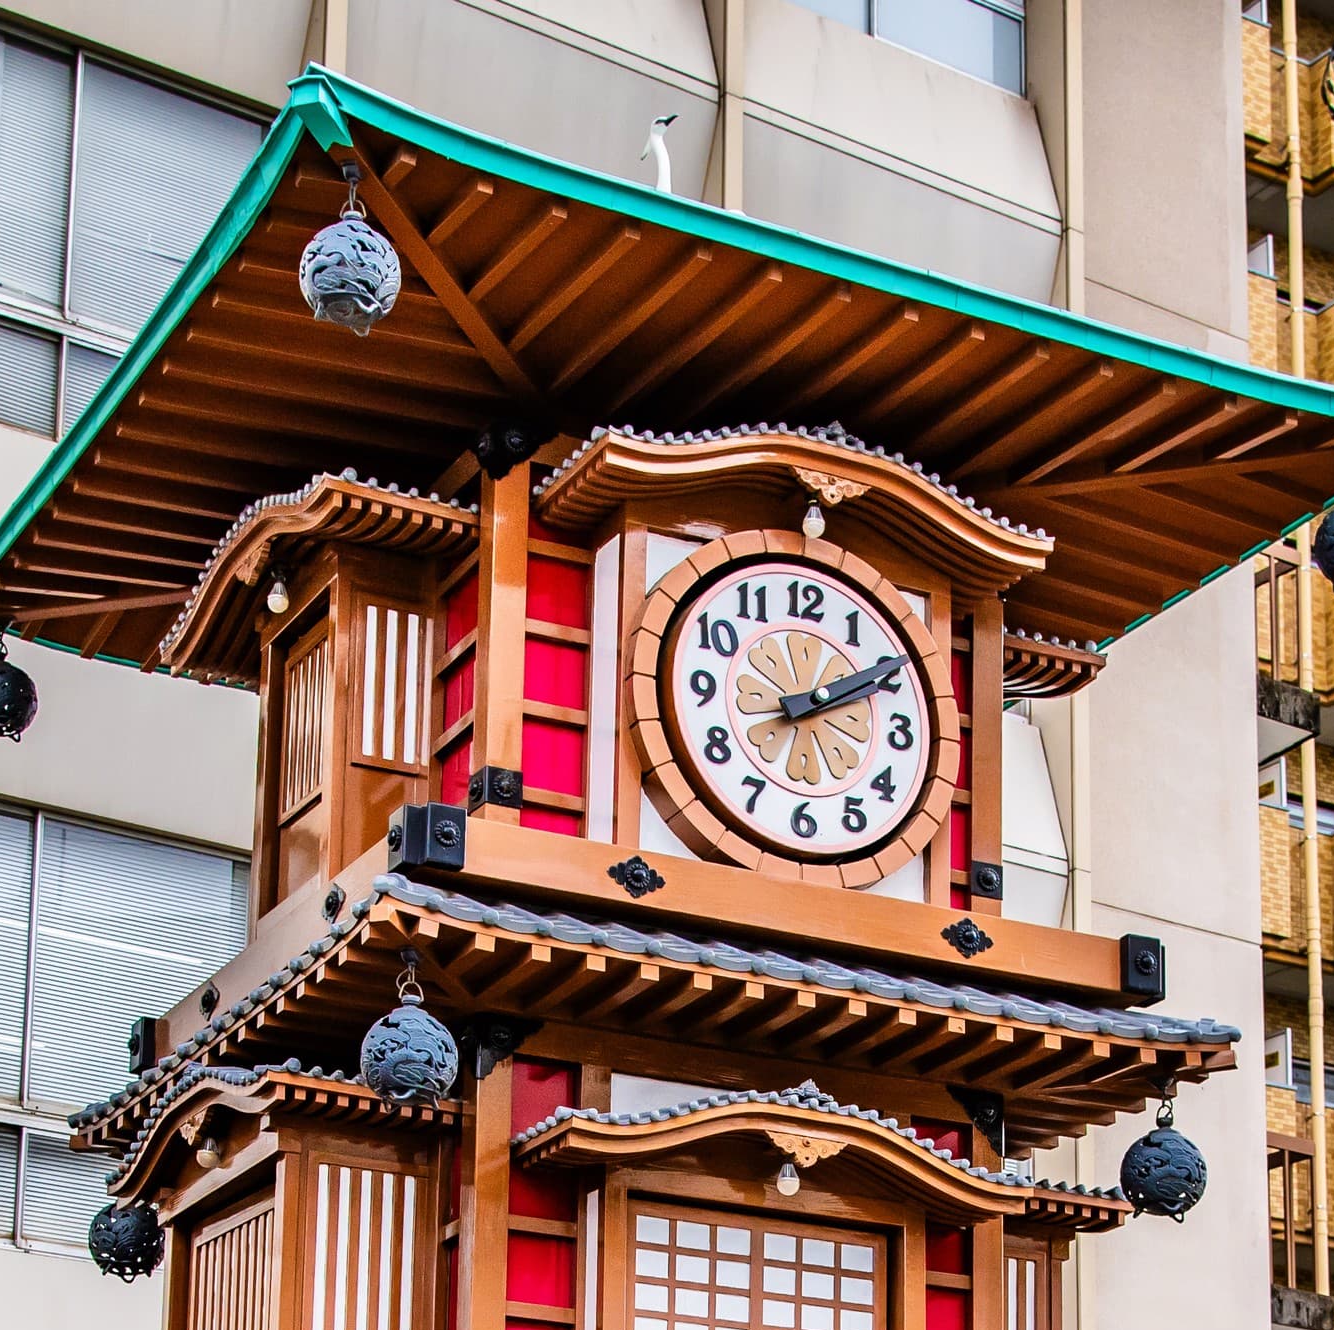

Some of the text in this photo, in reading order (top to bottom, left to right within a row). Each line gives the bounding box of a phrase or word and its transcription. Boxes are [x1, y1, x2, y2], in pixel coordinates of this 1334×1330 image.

[736, 582, 768, 622] 11
[787, 581, 825, 623] 12
[697, 612, 738, 656] 10
[845, 611, 860, 646] 1
[690, 670, 716, 707] 9
[704, 726, 731, 763] 8
[888, 713, 913, 750] 3
[741, 776, 766, 813] 7
[871, 766, 897, 801] 4
[791, 802, 817, 837] 6
[842, 796, 866, 832] 5
